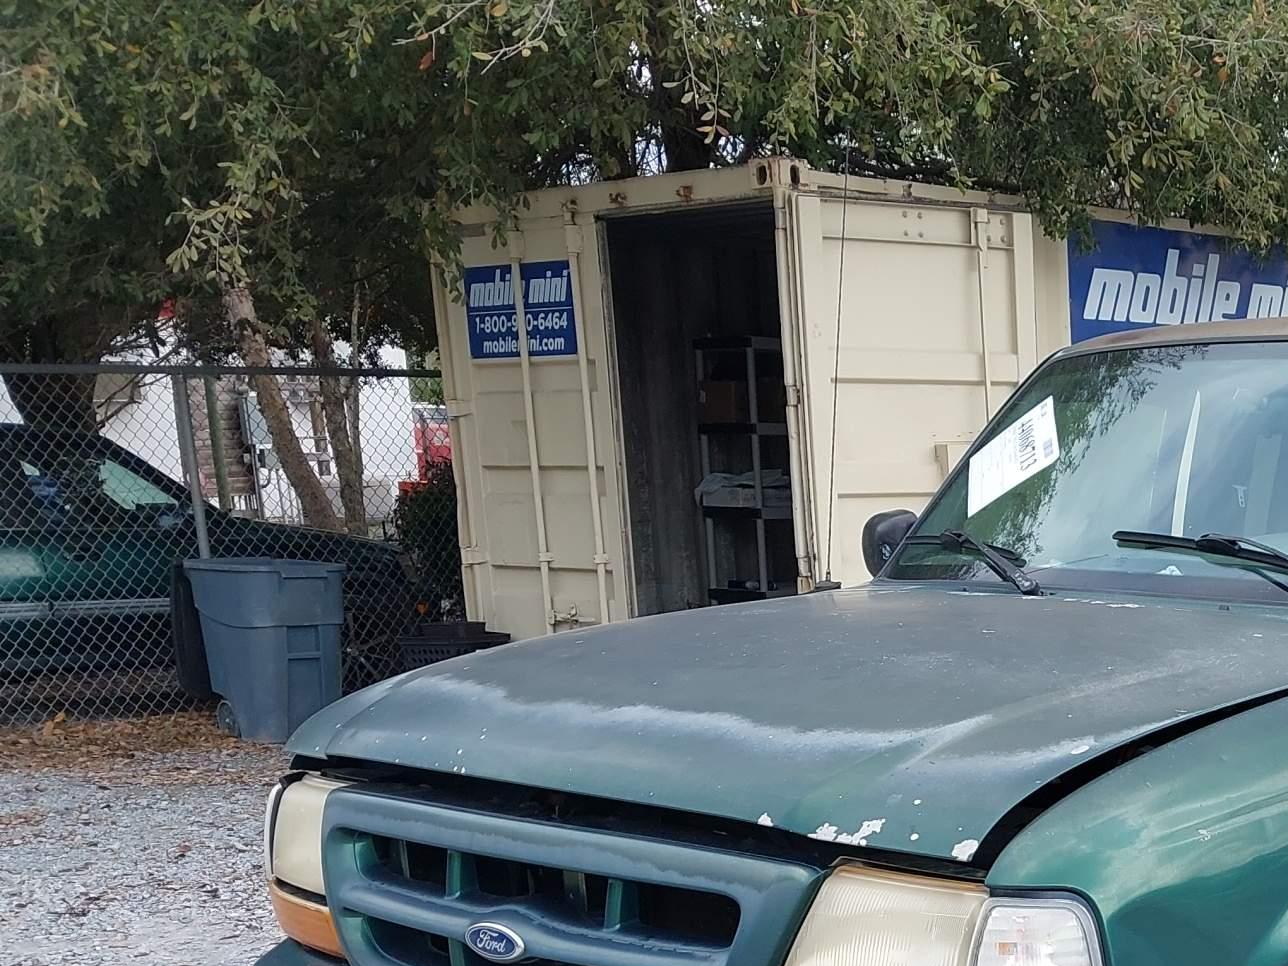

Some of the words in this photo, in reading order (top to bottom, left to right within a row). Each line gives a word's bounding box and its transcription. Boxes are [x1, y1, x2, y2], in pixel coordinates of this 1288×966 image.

[469, 269, 526, 308] mobil
[528, 270, 569, 304] mini
[1083, 249, 1241, 325] mobile
[475, 312, 568, 334] 1-800-90-6464
[483, 335, 565, 353] mobileini.com
[1018, 418, 1038, 472] 44068713
[476, 929, 506, 953] Ford
